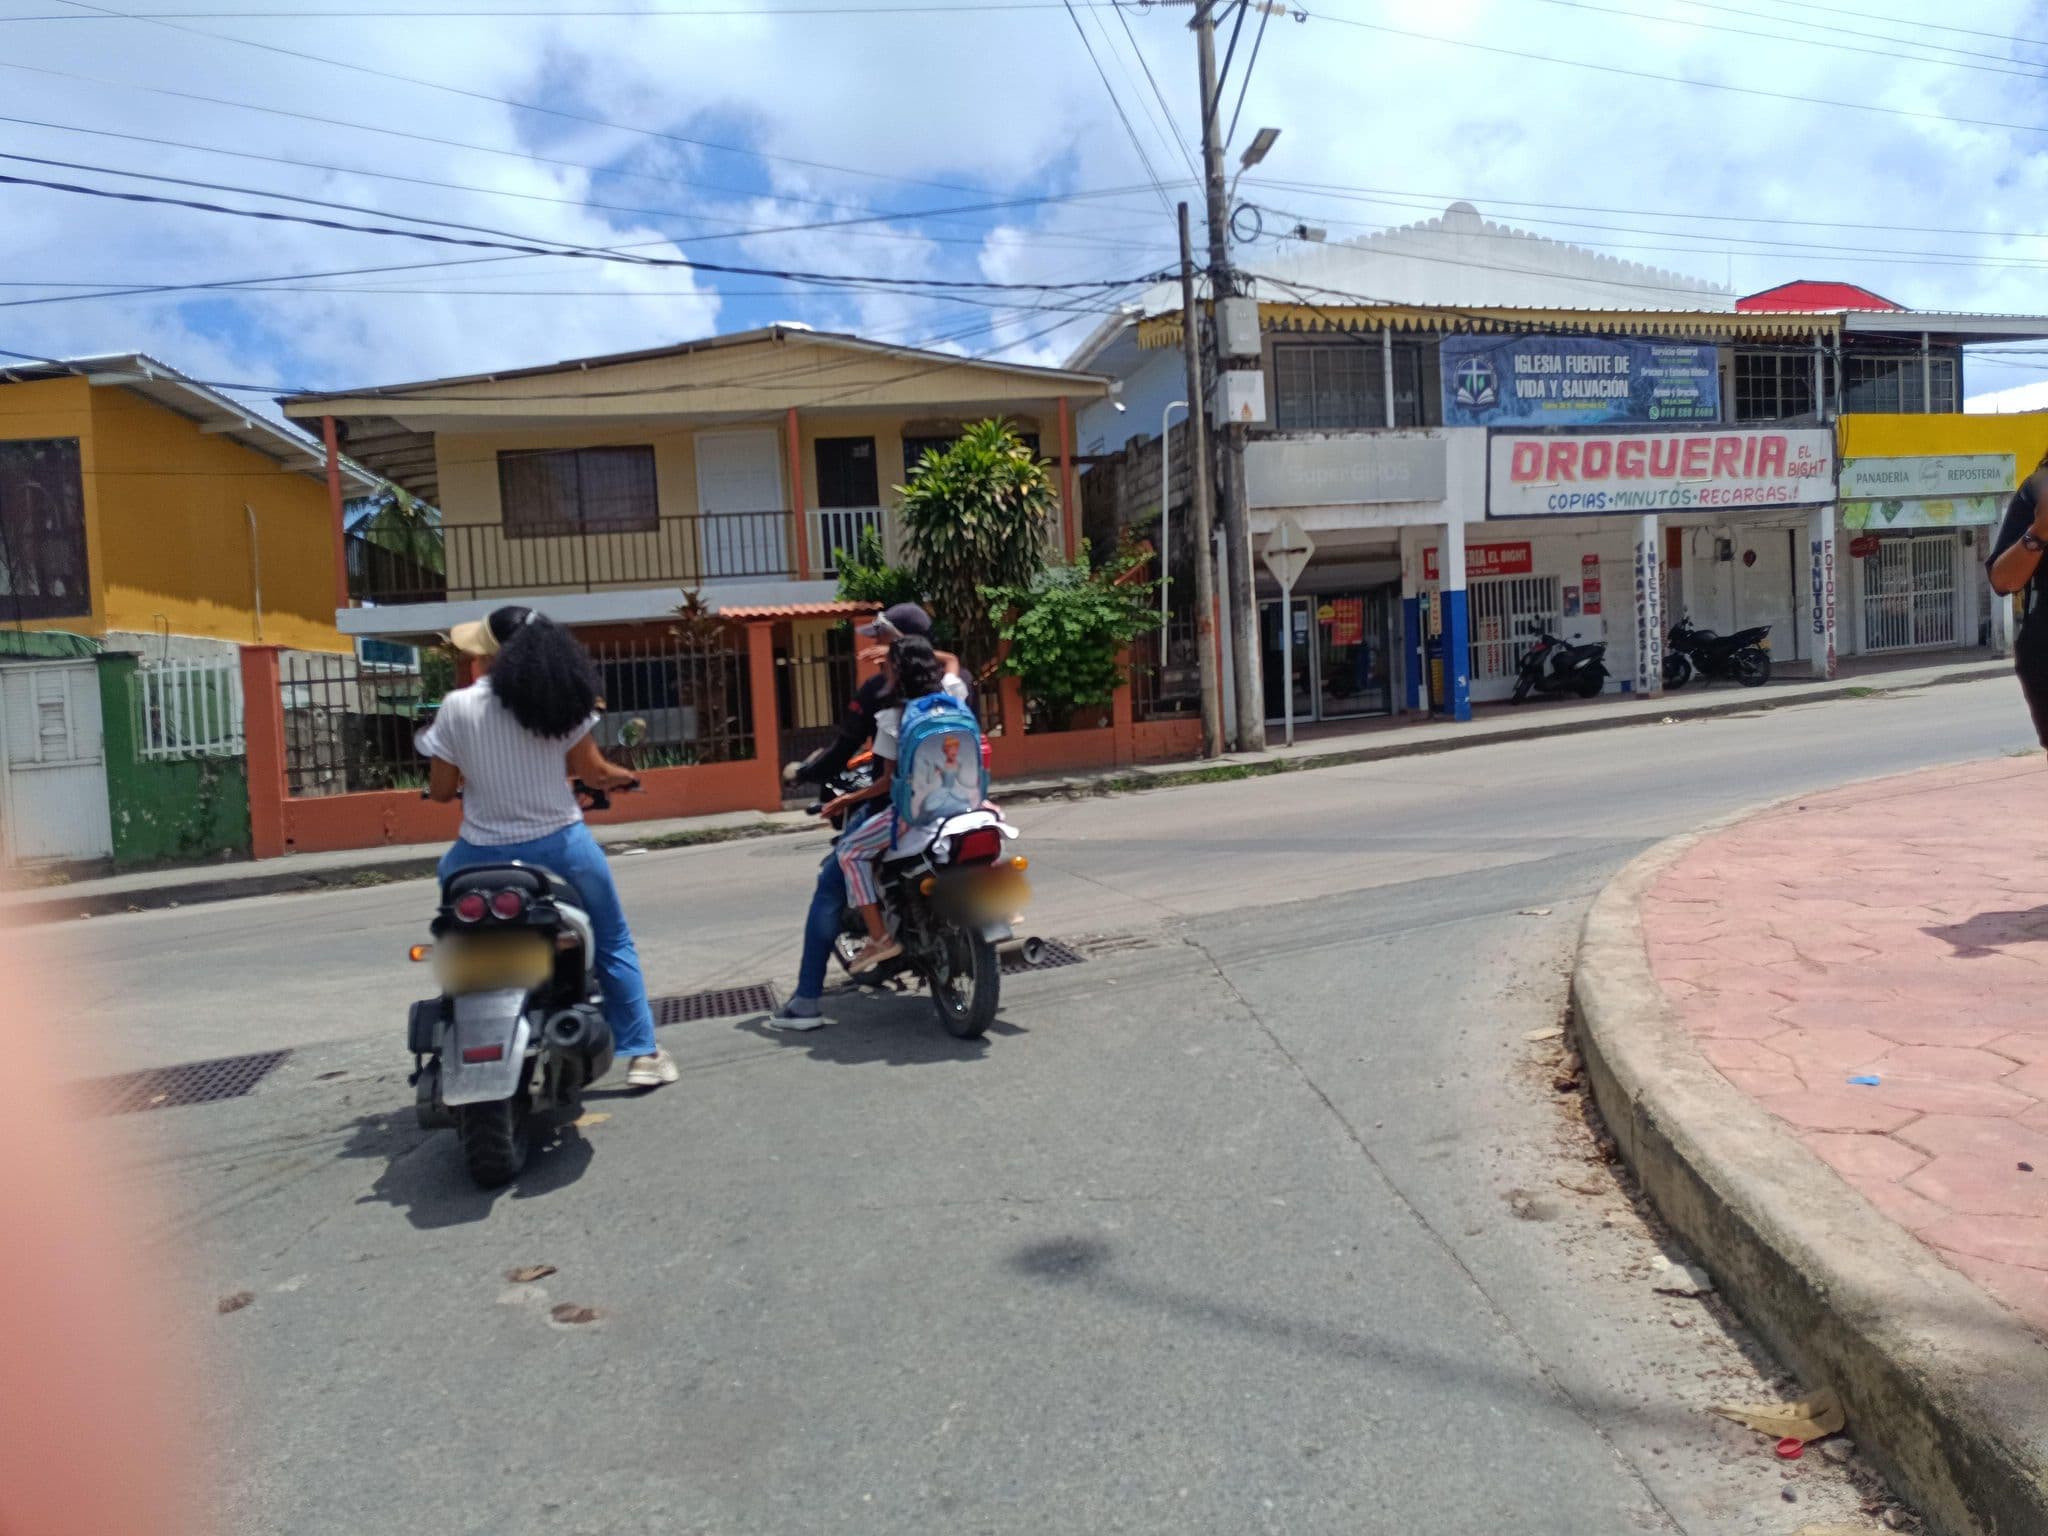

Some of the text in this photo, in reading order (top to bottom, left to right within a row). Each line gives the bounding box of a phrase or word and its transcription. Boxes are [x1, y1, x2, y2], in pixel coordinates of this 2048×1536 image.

[1514, 355, 1630, 373] IGLESIA FUENTE DE
[1516, 376, 1629, 398] VIDA Y SALVACIÓN
[1510, 436, 1789, 481] DROGUERIA
[1798, 445, 1811, 459] EL
[1788, 459, 1827, 477] BIGHT
[1856, 471, 1910, 484] PANADERIA
[1548, 492, 1605, 510] COPIAS
[1613, 489, 1691, 507] MINUTOS
[1811, 541, 1824, 634] MINUTOS
